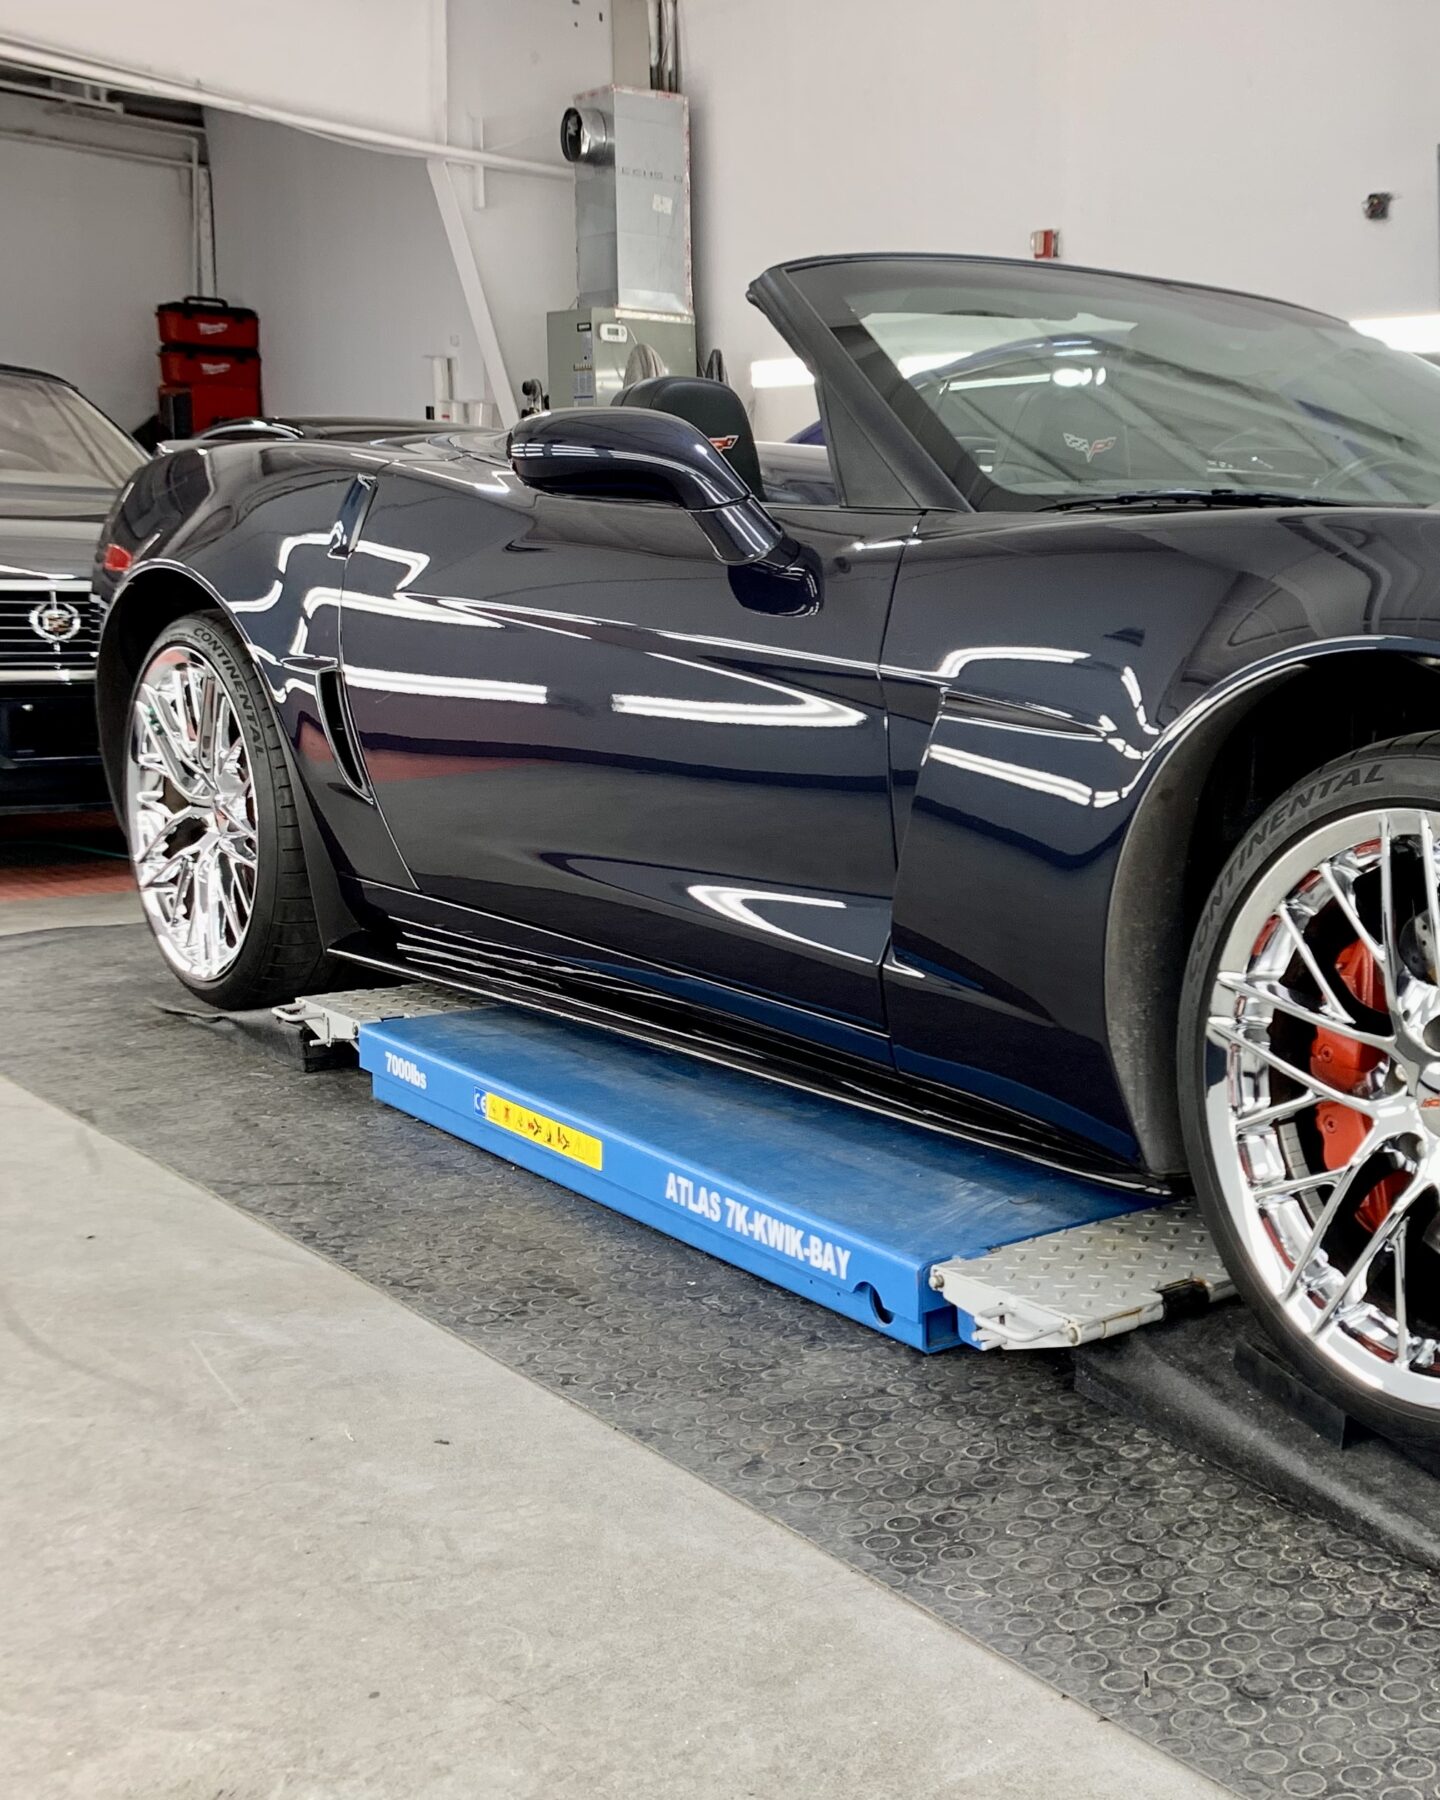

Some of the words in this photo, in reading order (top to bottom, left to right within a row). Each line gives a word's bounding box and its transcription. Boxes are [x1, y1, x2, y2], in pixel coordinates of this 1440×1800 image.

[193, 628, 264, 758] CONTINENTAL
[1189, 764, 1385, 984] CONTINENTAL
[385, 1051, 427, 1090] 7000lbs
[665, 1172, 722, 1223] ATLAS
[725, 1197, 851, 1280] 7K-KWIK-BAY
